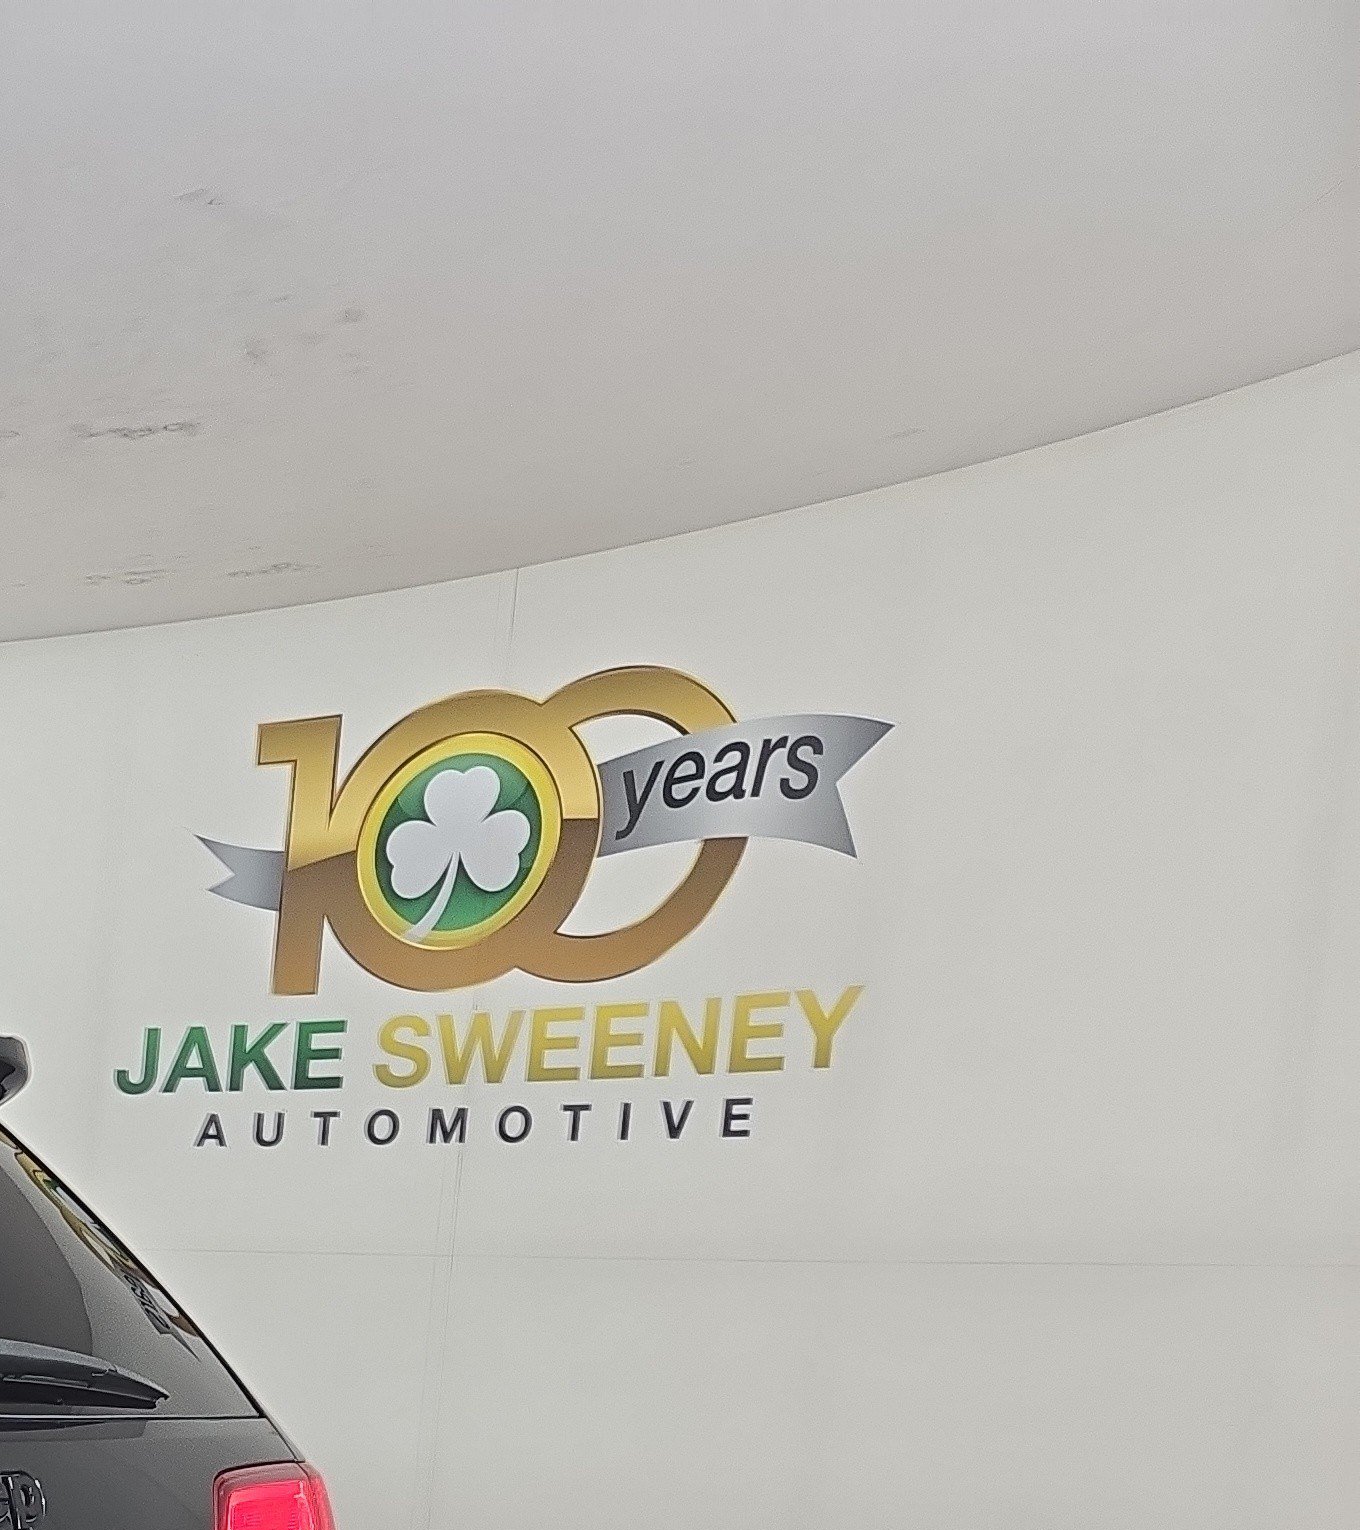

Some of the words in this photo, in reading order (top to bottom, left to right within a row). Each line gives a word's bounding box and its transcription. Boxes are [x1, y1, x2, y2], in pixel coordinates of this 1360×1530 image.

[613, 728, 825, 842] years
[112, 1018, 349, 1097] JAKE
[371, 985, 867, 1091] SWEENEY
[194, 1096, 756, 1149] AUTOMOTIVE
